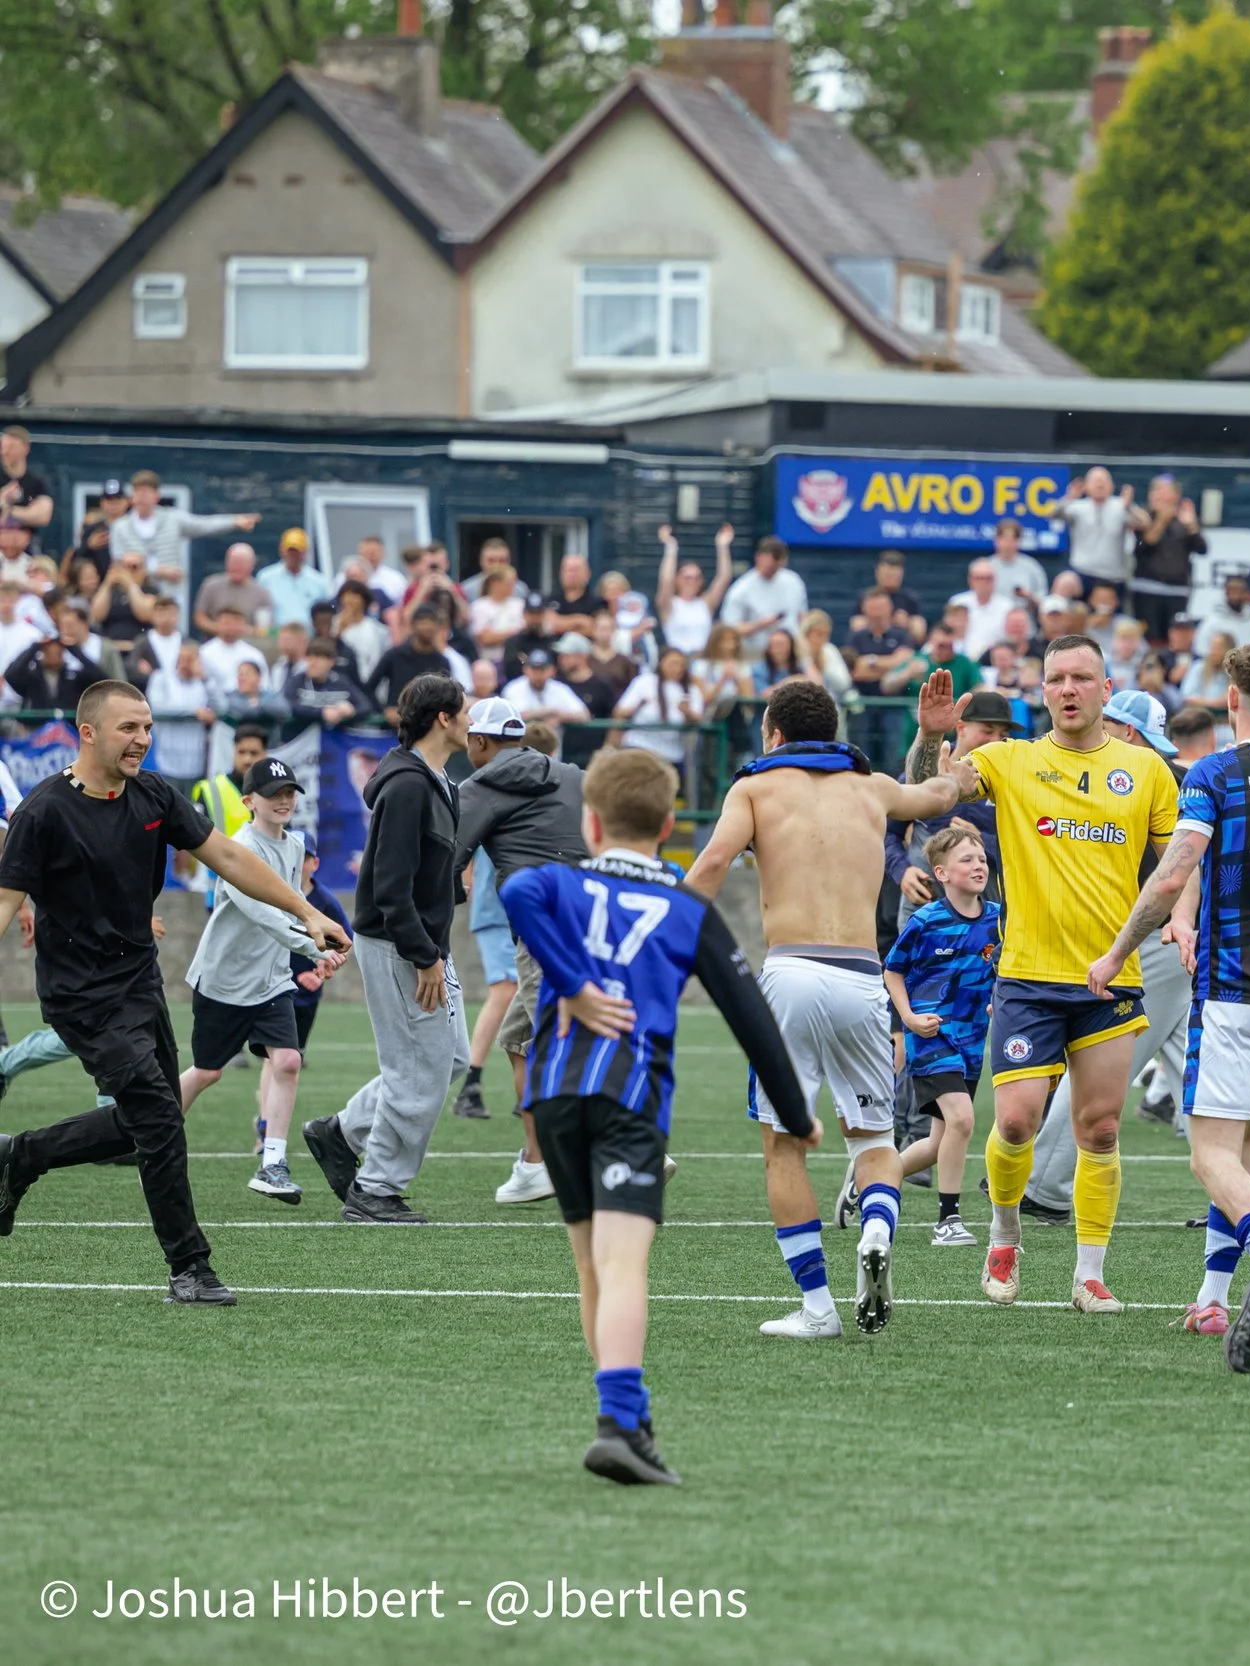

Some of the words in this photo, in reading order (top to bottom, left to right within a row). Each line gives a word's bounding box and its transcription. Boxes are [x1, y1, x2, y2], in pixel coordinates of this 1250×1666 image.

[860, 471, 985, 516] AVRO
[1077, 771, 1089, 794] 4
[1055, 817, 1127, 845] Fidelis
[582, 877, 671, 966] 17
